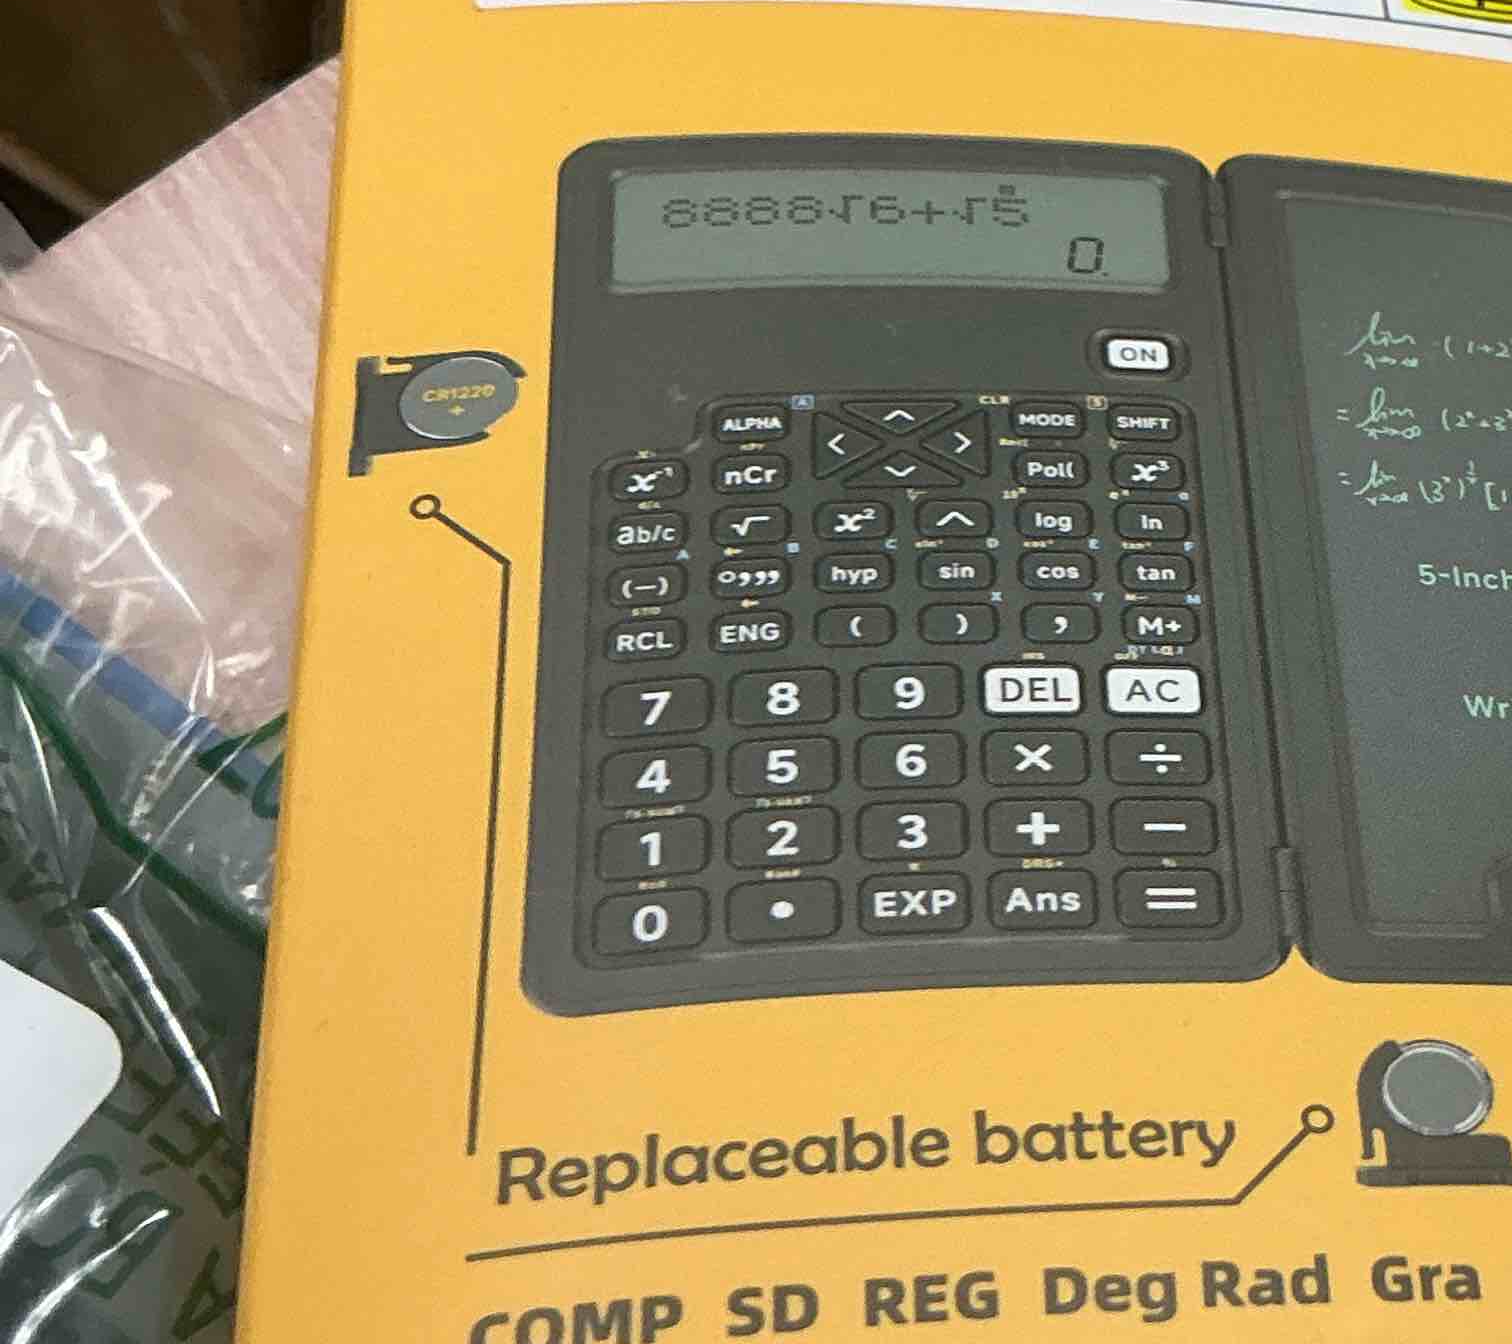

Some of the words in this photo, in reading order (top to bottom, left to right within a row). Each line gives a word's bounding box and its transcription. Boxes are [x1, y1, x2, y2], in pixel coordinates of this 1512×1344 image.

[1119, 345, 1158, 364] ON
[720, 416, 784, 433] ALPHA
[1018, 412, 1077, 428] MODE
[1115, 415, 1172, 432] SHIFT
[723, 465, 779, 486] nCr
[616, 524, 677, 546] ab/c
[1034, 512, 1074, 533] log
[830, 565, 879, 586] hyp
[936, 562, 976, 580] sin
[1035, 564, 1081, 580] cos
[1135, 565, 1176, 582] tan
[719, 622, 780, 645] ENG
[1136, 615, 1183, 637] M+
[615, 631, 674, 653] RCL
[766, 680, 801, 716] 8
[892, 676, 927, 711] 9
[1000, 677, 1072, 703] DEL
[1125, 679, 1180, 703] AC
[639, 688, 673, 728] 7
[765, 748, 800, 786] 5
[895, 742, 928, 778] 6
[635, 758, 672, 794] 4
[765, 819, 800, 857] 2
[896, 813, 929, 850] 3
[638, 831, 662, 867] 1
[872, 890, 958, 918] EXP
[1005, 887, 1082, 914] Ans
[632, 904, 670, 944] 0
[496, 1112, 951, 1206] Replaceable
[974, 1108, 1236, 1168] battery
[725, 1282, 820, 1338] SD
[863, 1269, 1001, 1328] REG
[1042, 1264, 1178, 1324] Deg
[1201, 1252, 1332, 1309] Rad
[1370, 1254, 1482, 1304] Gra
